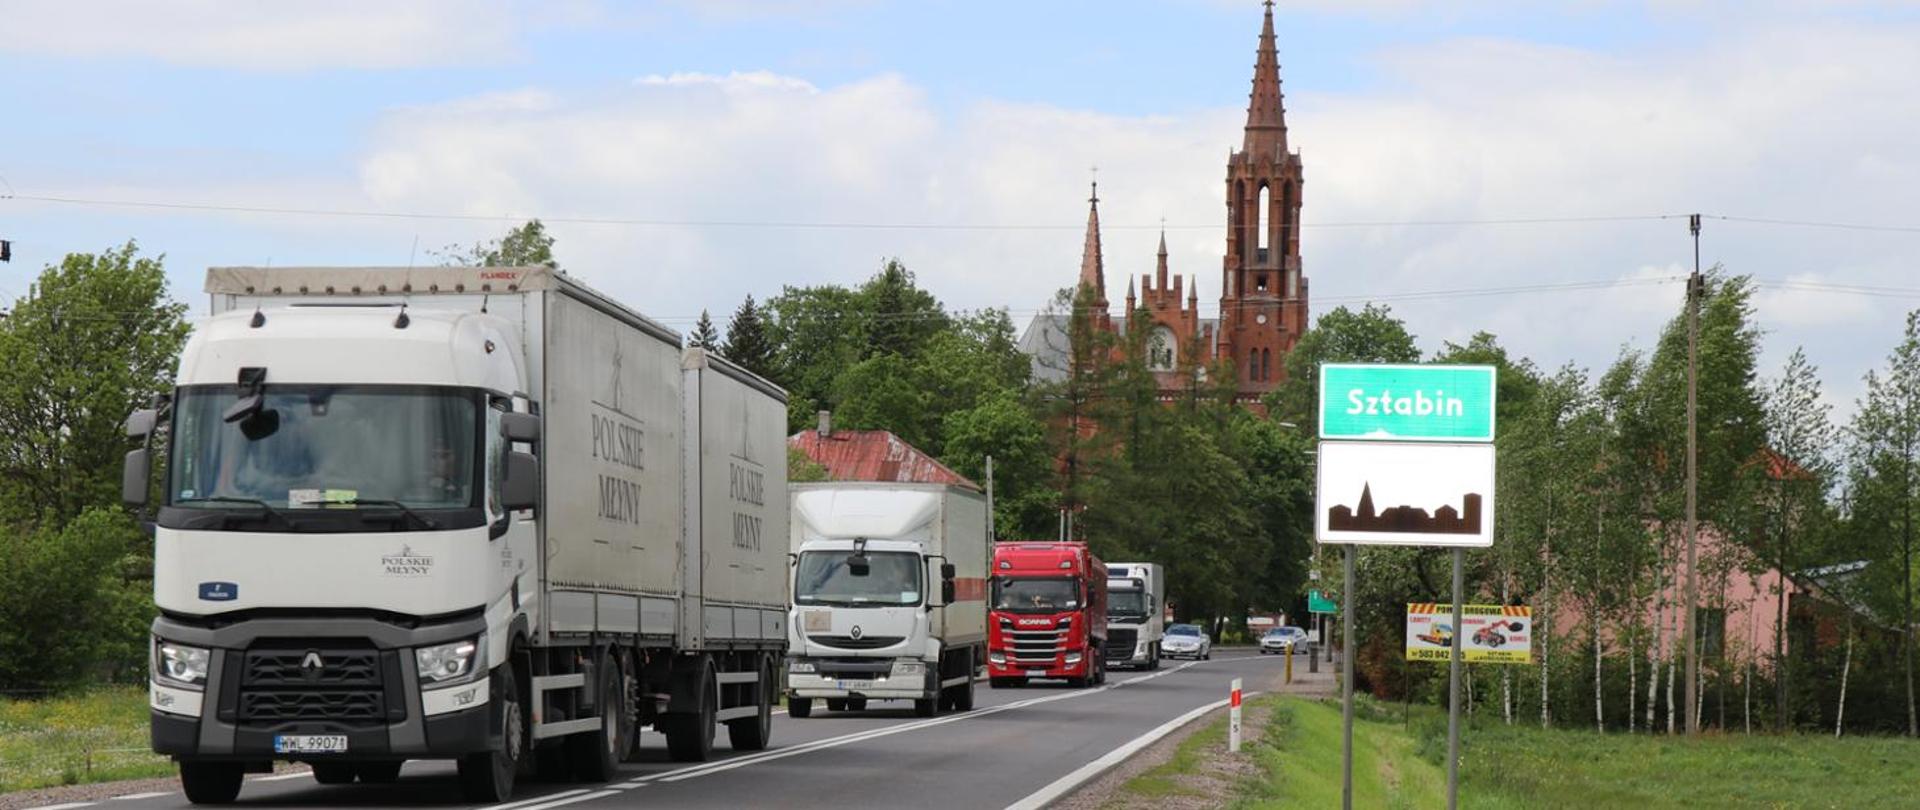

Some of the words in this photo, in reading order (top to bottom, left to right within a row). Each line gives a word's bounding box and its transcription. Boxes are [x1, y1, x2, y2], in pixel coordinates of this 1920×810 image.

[1346, 388, 1463, 416] Sztabin
[591, 414, 644, 470] POLSKIE
[598, 474, 642, 524] MŁYNY
[730, 463, 764, 506] POLSKIE
[382, 558, 433, 566] POLSKIE
